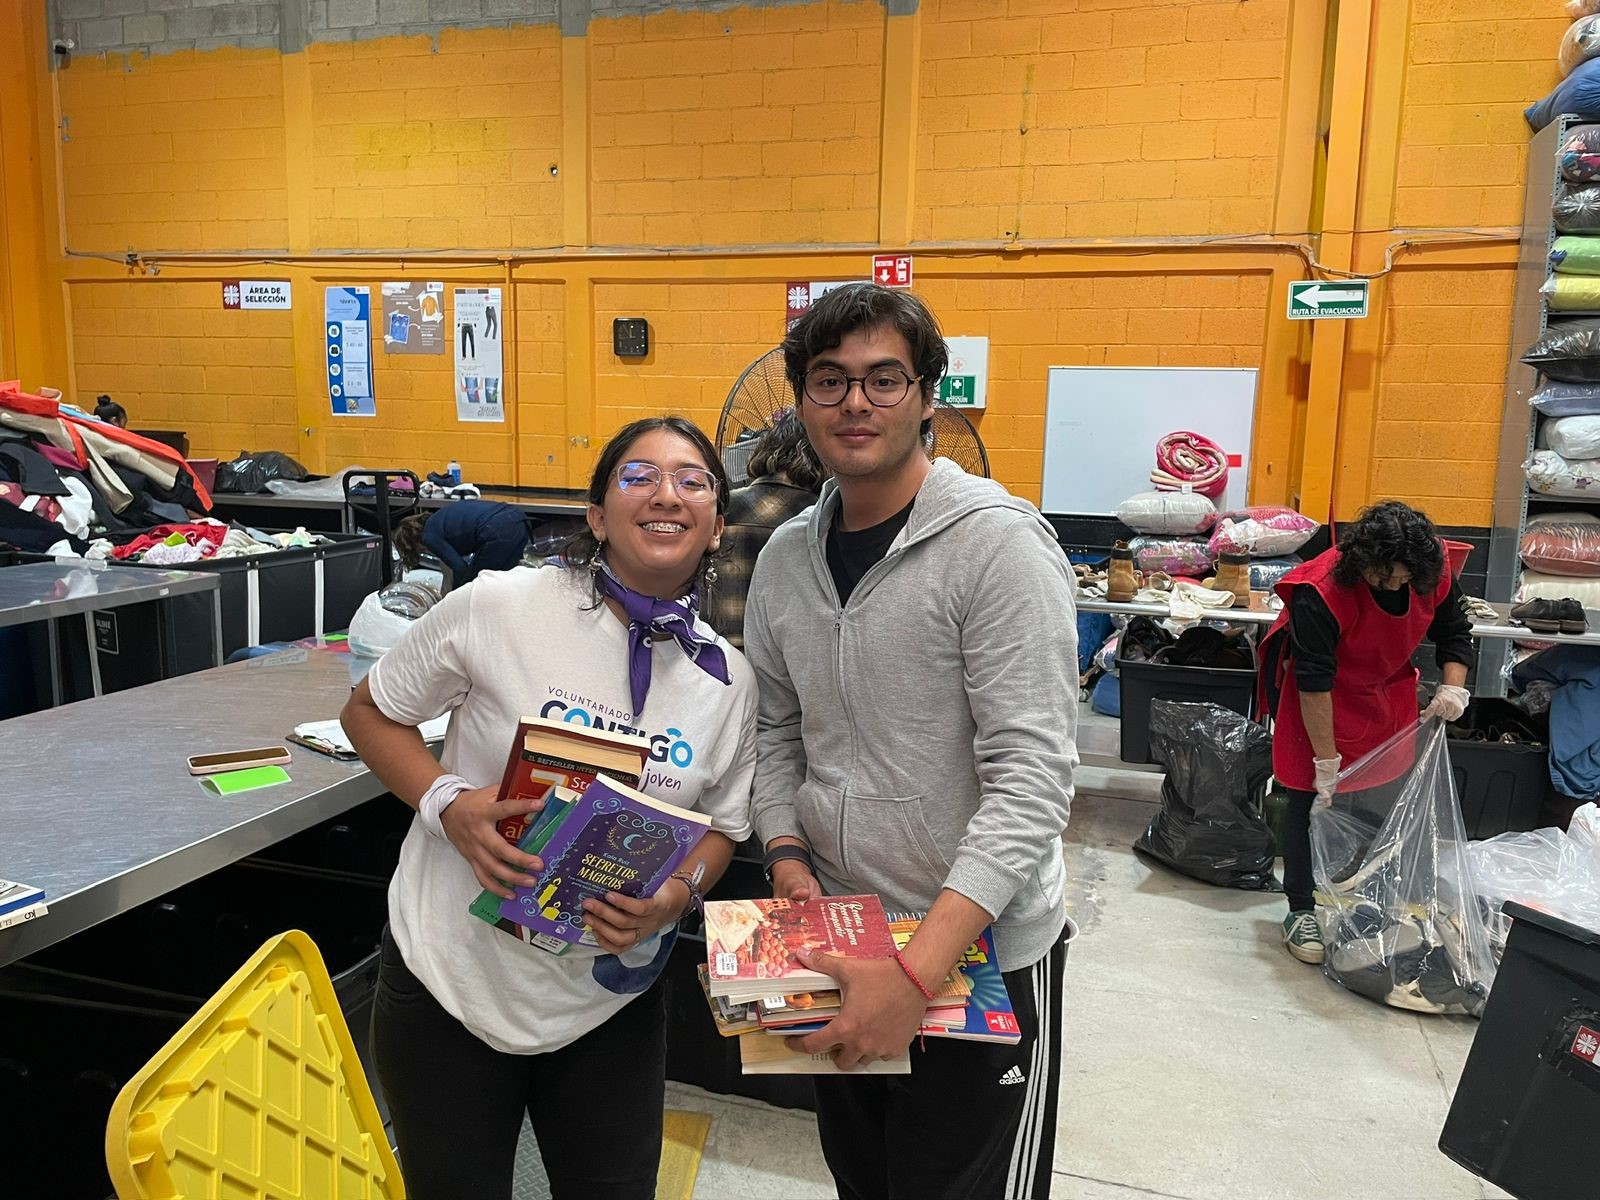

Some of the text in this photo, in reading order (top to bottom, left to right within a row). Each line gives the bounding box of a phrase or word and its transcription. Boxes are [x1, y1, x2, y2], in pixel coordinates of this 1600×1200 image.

[245, 294, 286, 303] SELECCIÓN
[249, 285, 269, 294] ÁREA
[548, 685, 631, 721] VOLUNTARIADO
[540, 699, 693, 768] COGO
[537, 757, 576, 771] BESTSELLER
[640, 768, 682, 791] joven
[577, 866, 626, 891] MÁGICOS
[581, 853, 639, 880] SECRETOS
[828, 902, 846, 938] Compartir
[837, 902, 858, 945] Secretos para
[849, 900, 864, 927] Recetas
[998, 1075, 1026, 1085] adidas
